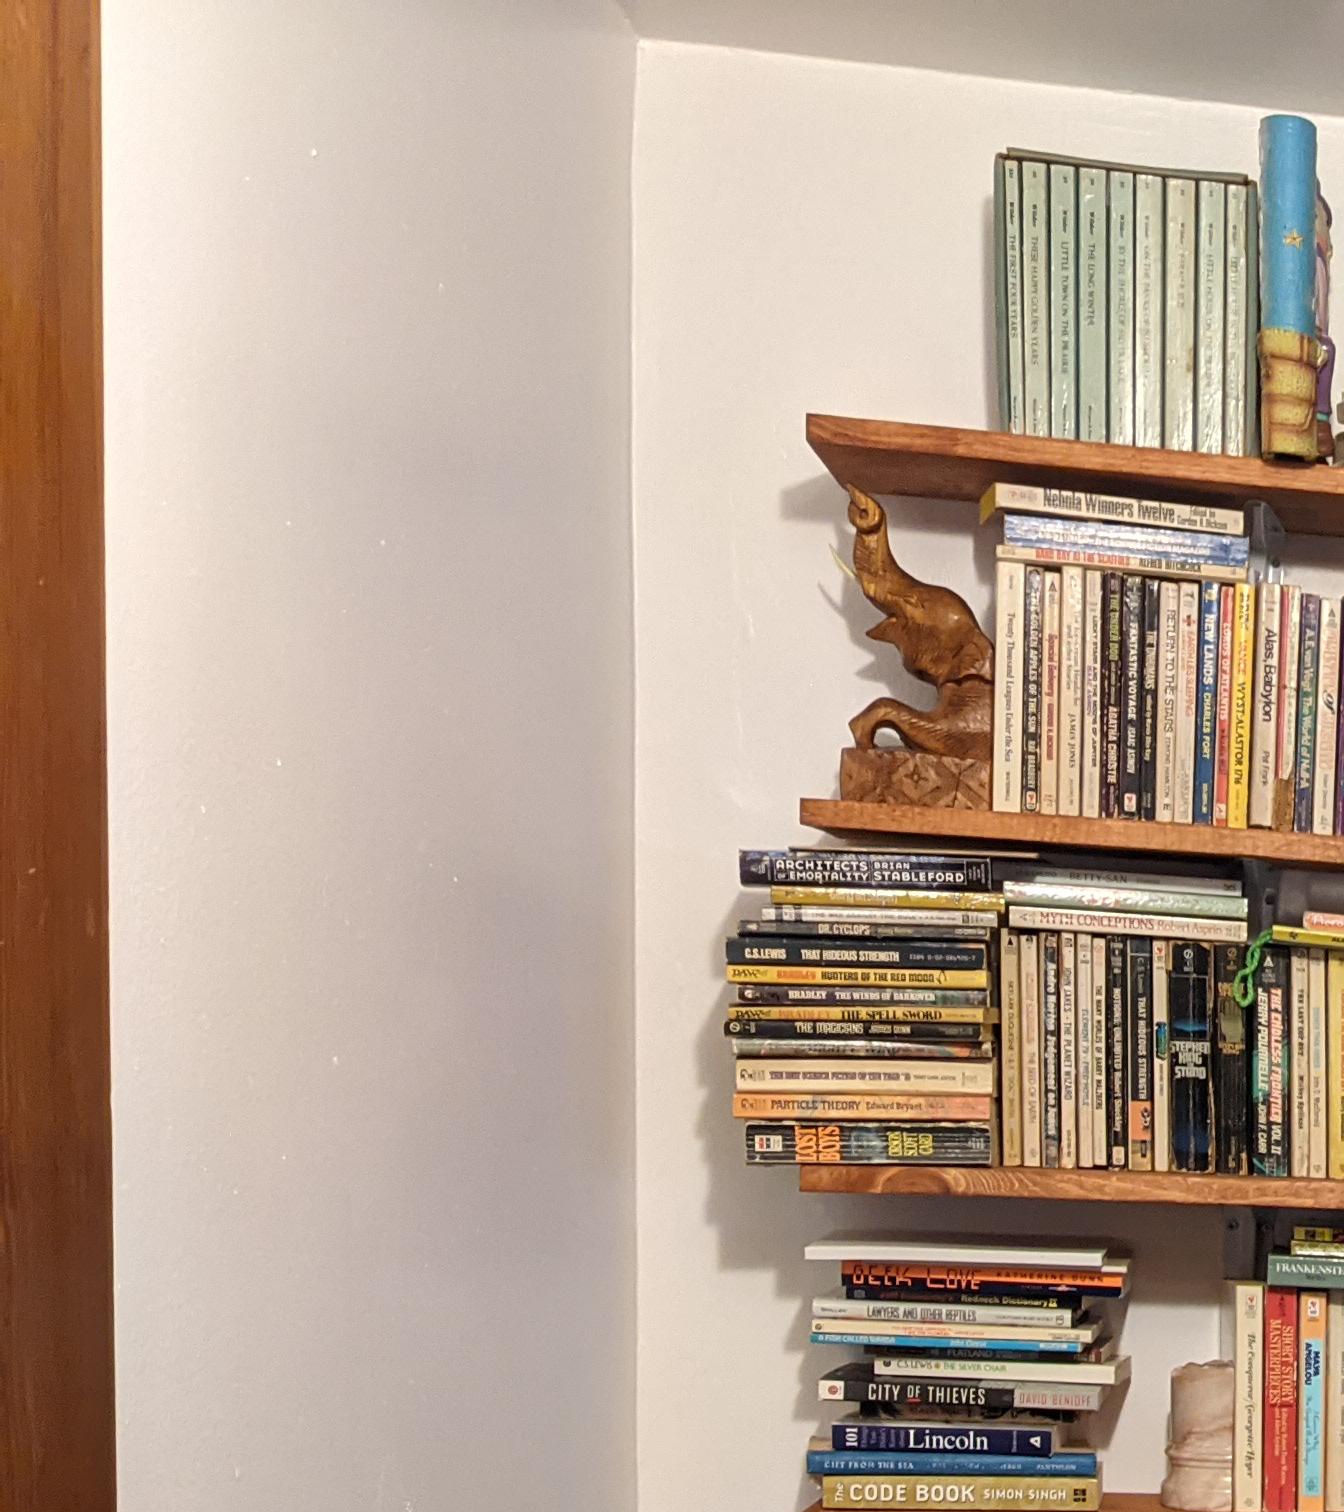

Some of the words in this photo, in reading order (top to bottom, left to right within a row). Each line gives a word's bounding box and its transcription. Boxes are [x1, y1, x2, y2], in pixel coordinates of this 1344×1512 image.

[776, 859, 868, 872] ARCHITECTS
[874, 861, 911, 871] BRIAN
[789, 870, 868, 882] EMORTALITY
[873, 870, 966, 883] STABLEFORD
[770, 1100, 814, 1111] PARTICLE
[818, 1100, 860, 1111] THEORY
[868, 1383, 900, 1401] CITY
[907, 1385, 921, 1400] OF
[928, 1385, 986, 1405] THIEVES
[1018, 1393, 1047, 1406] DAVID
[908, 1429, 988, 1451] Lincoln
[850, 1483, 907, 1502] CODE
[915, 1483, 976, 1502] BOOK
[983, 1489, 1023, 1500] SIMON
[1028, 1488, 1066, 1500] SINGH
